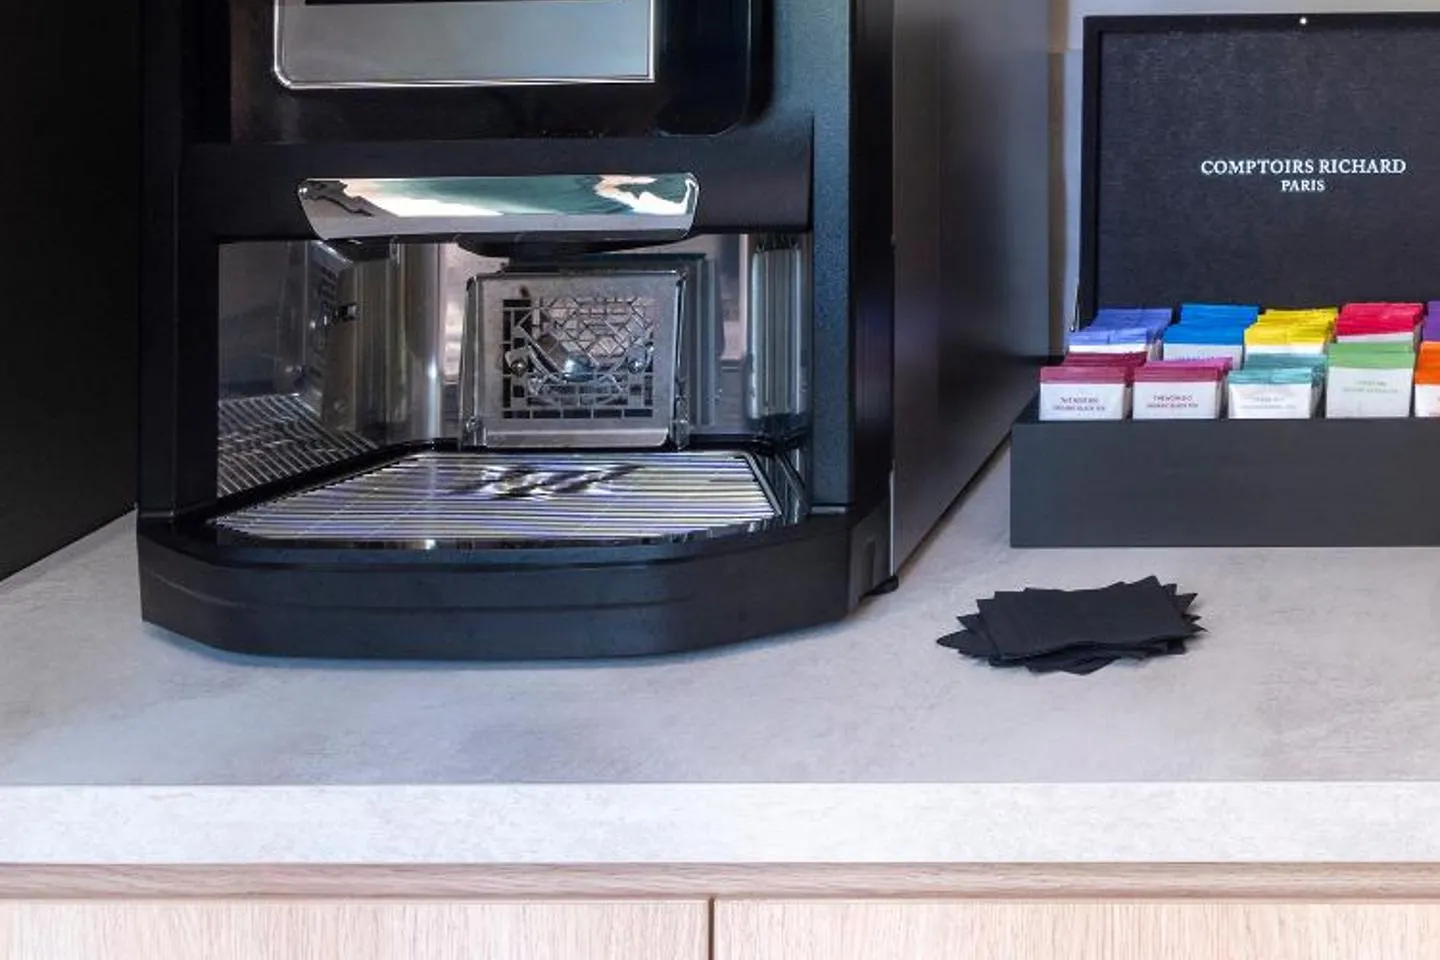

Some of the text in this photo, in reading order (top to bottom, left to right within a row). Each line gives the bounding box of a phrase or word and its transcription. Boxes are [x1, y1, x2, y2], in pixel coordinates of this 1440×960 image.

[1201, 158, 1406, 175] COMPTOIRS RICHARD
[1281, 180, 1325, 192] PARIS
